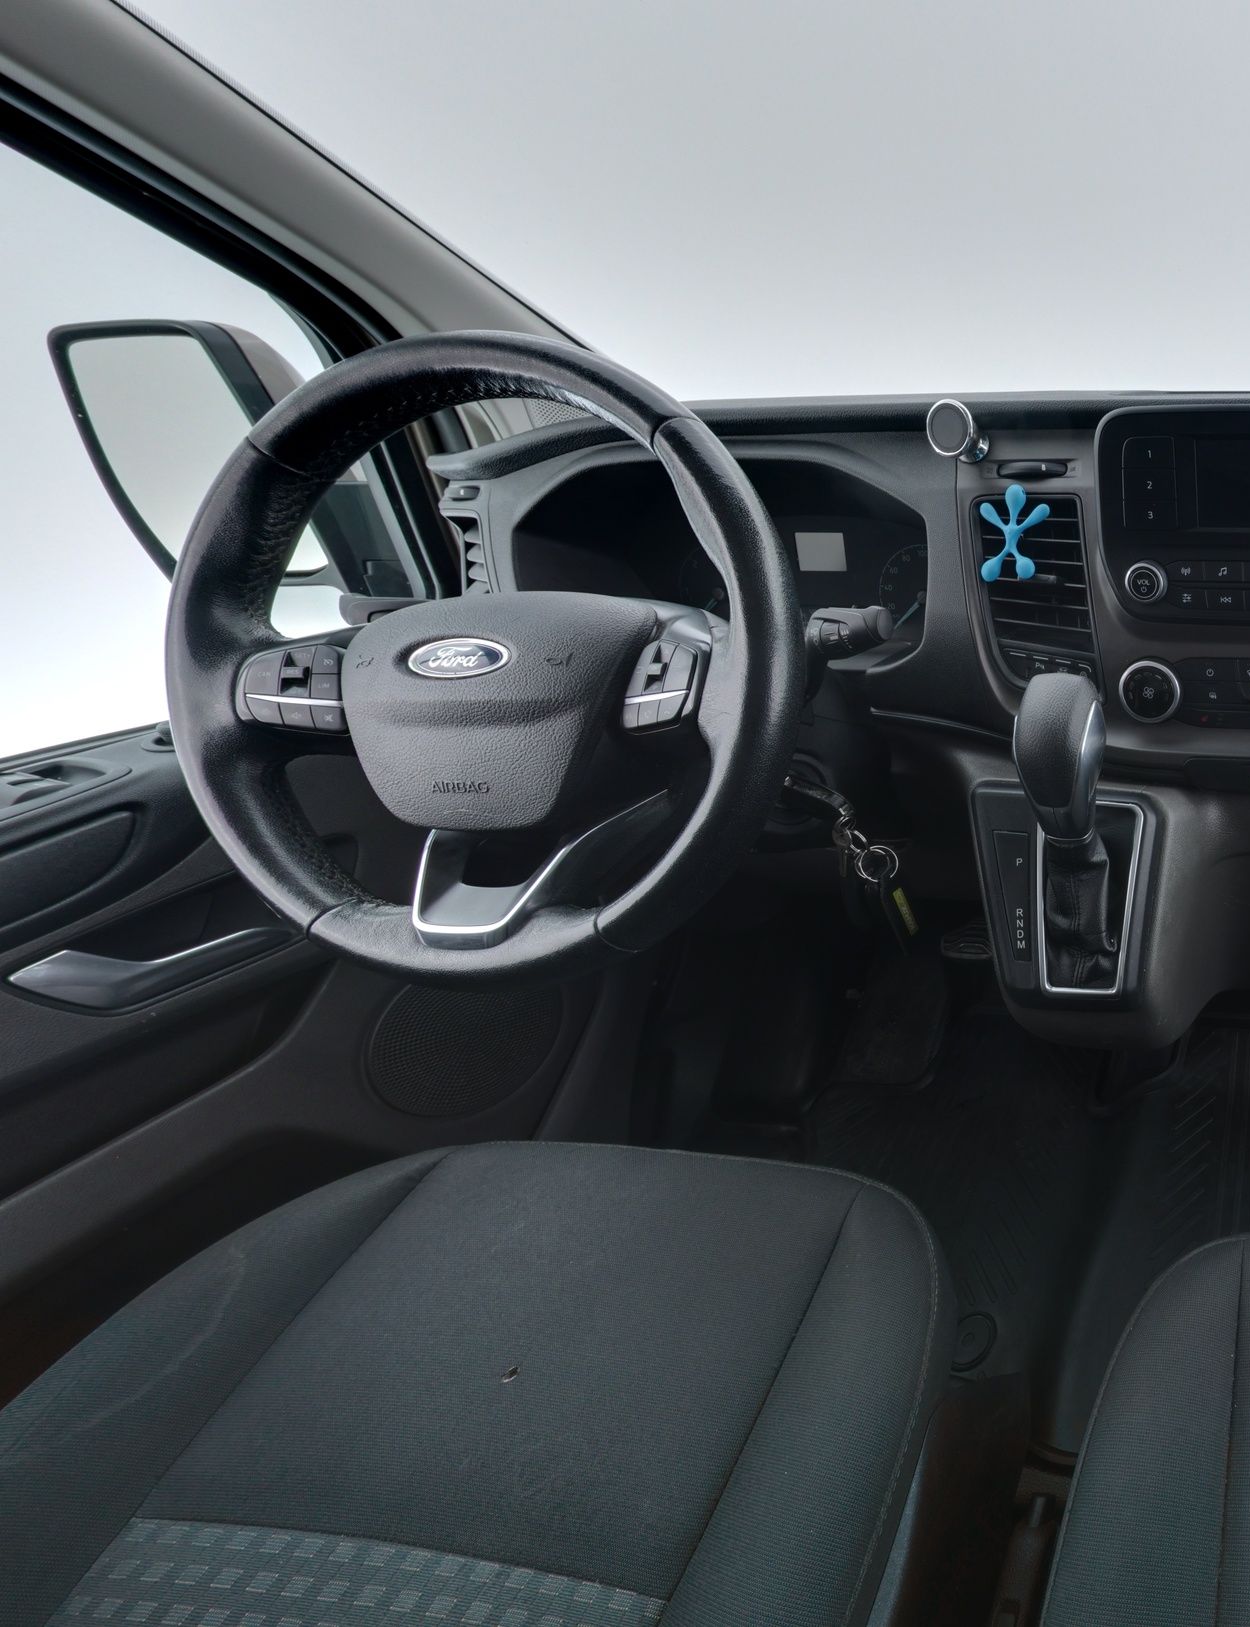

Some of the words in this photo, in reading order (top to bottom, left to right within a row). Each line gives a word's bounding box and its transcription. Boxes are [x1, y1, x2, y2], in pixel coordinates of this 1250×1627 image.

[1147, 450, 1153, 459] 1
[1146, 481, 1153, 490] 2
[1147, 510, 1153, 520] 3
[428, 646, 484, 668] Ford
[431, 780, 490, 794] AIRBAG
[1016, 858, 1023, 866] P
[1016, 908, 1023, 917] R
[1016, 919, 1024, 928] N
[1016, 929, 1024, 938] D
[1017, 940, 1026, 949] M
